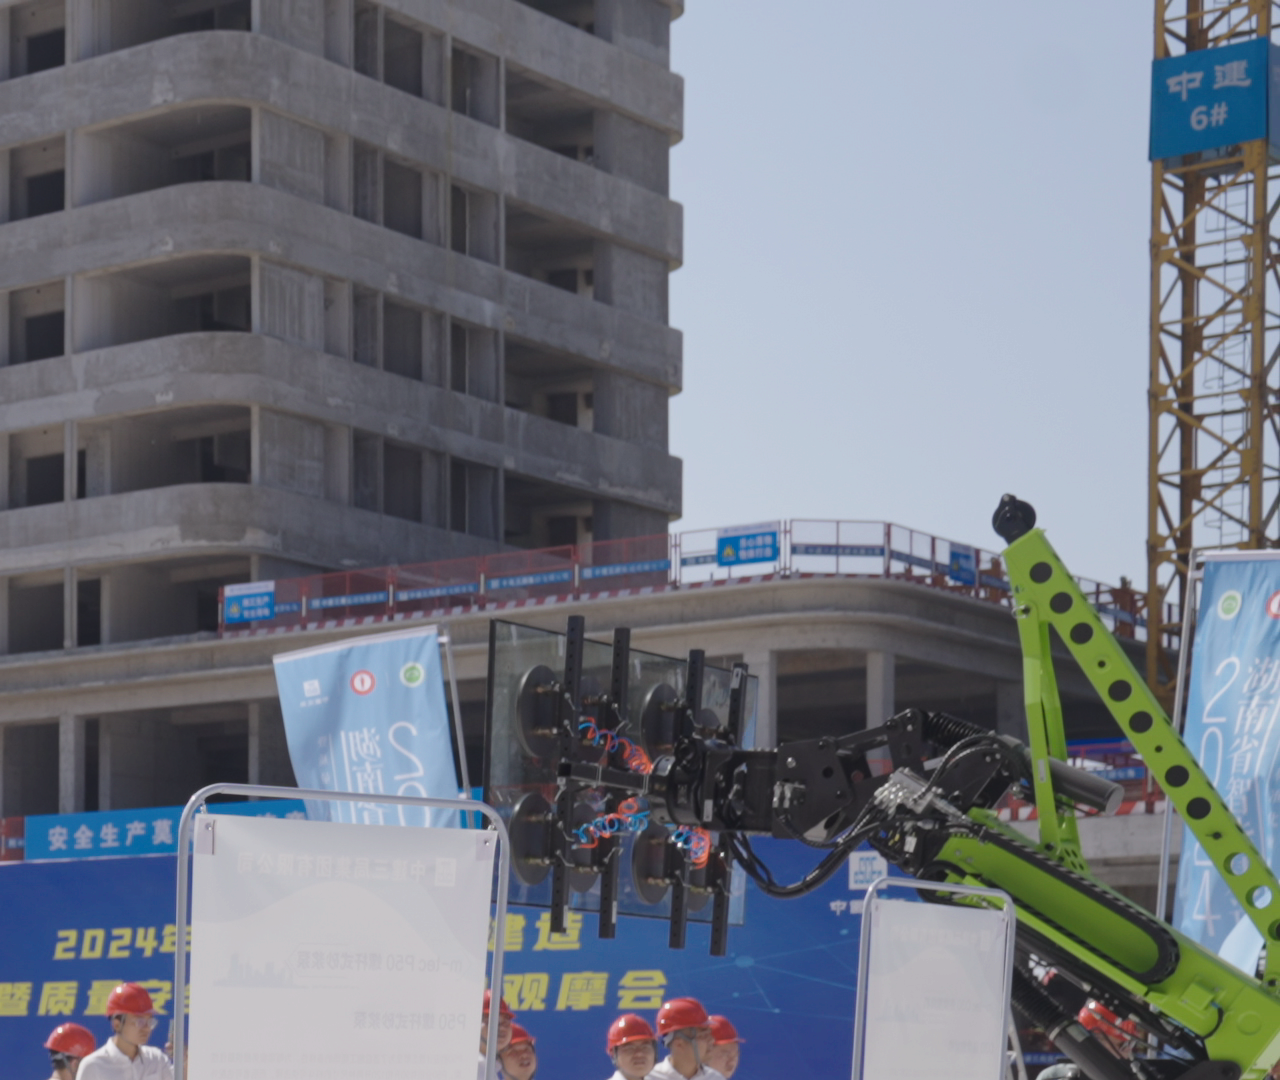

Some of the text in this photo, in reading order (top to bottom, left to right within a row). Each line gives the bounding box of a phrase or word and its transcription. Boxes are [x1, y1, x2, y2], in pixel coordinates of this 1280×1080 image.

[1166, 59, 1252, 101] 中建
[1190, 102, 1228, 131] 6#
[48, 818, 175, 851] 安全生产莫
